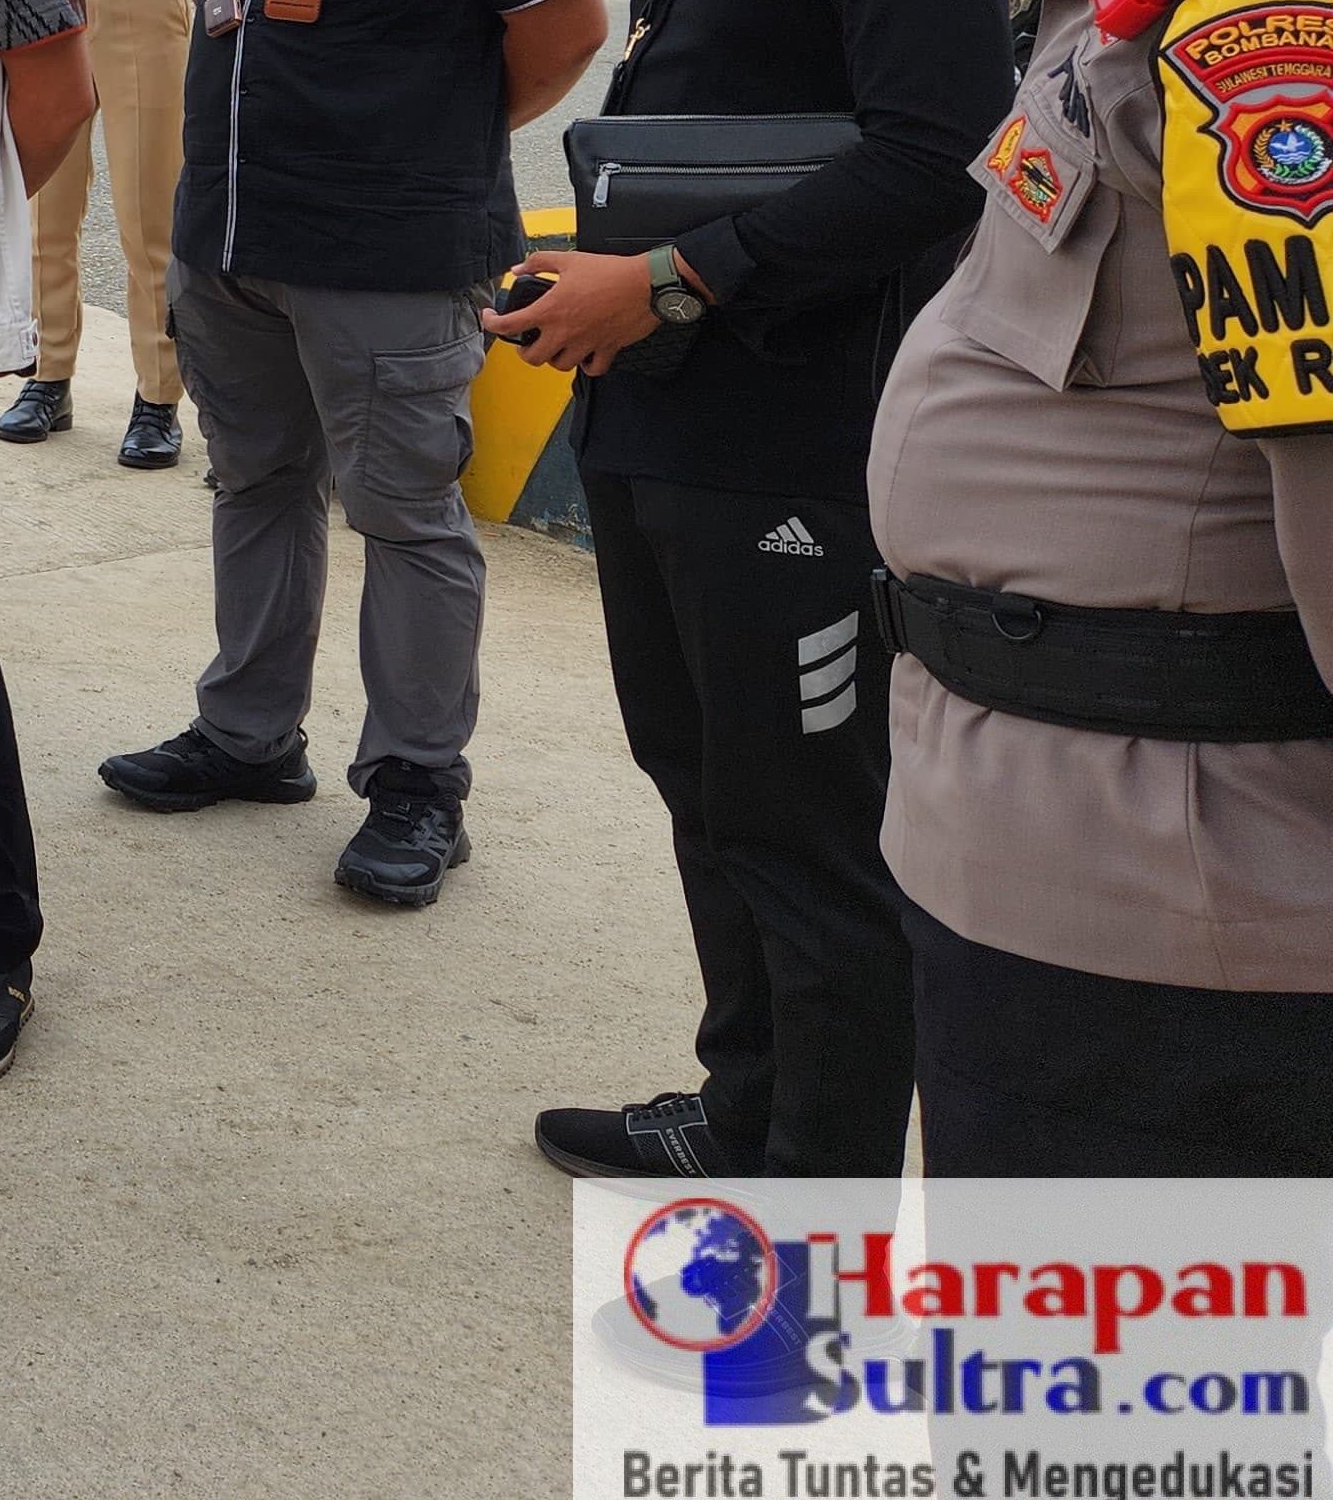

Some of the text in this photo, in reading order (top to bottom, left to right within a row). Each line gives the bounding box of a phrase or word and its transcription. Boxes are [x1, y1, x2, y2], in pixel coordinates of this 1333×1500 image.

[1216, 65, 1268, 93] SULAWESI
[1169, 234, 1331, 349] PAM
[1197, 346, 1270, 407] EK
[758, 539, 824, 557] adidas
